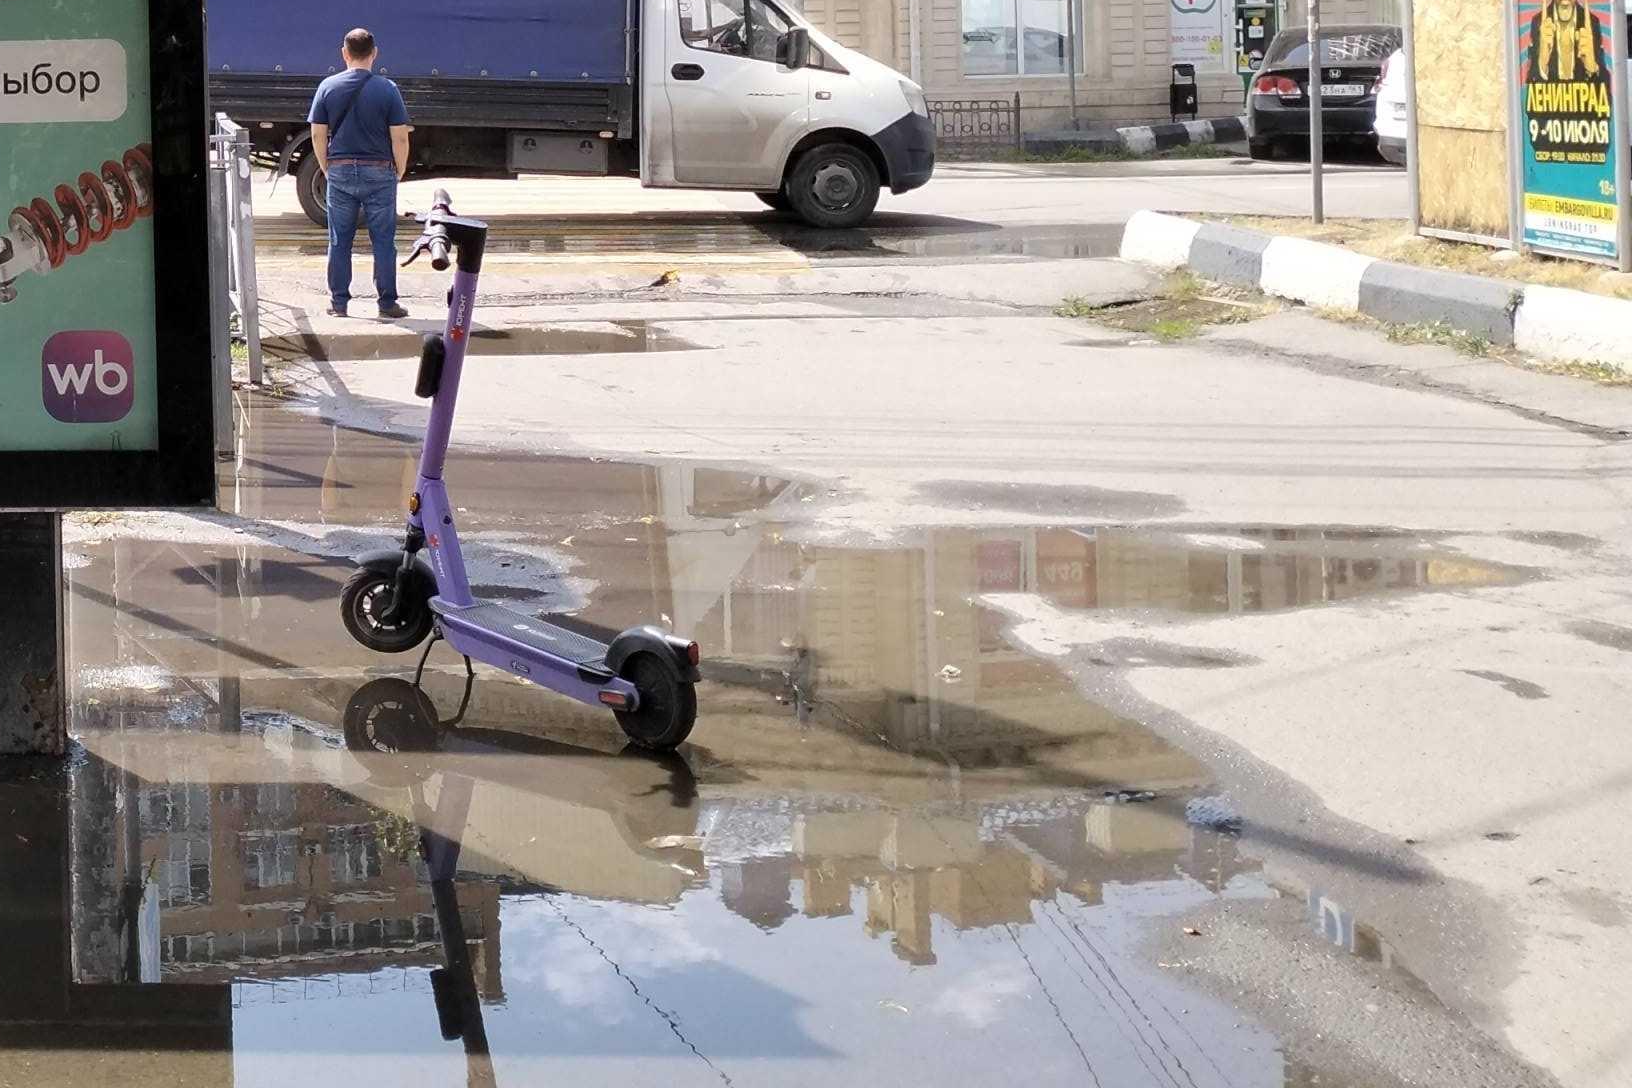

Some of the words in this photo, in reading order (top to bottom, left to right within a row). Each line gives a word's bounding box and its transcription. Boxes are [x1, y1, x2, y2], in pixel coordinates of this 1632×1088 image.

[1526, 82, 1611, 118] ЛЕНИНГРАД
[1563, 120, 1610, 145] ИЮЛЯ
[1555, 200, 1614, 221] EMBARGOVILLA.RU
[47, 348, 129, 396] wb
